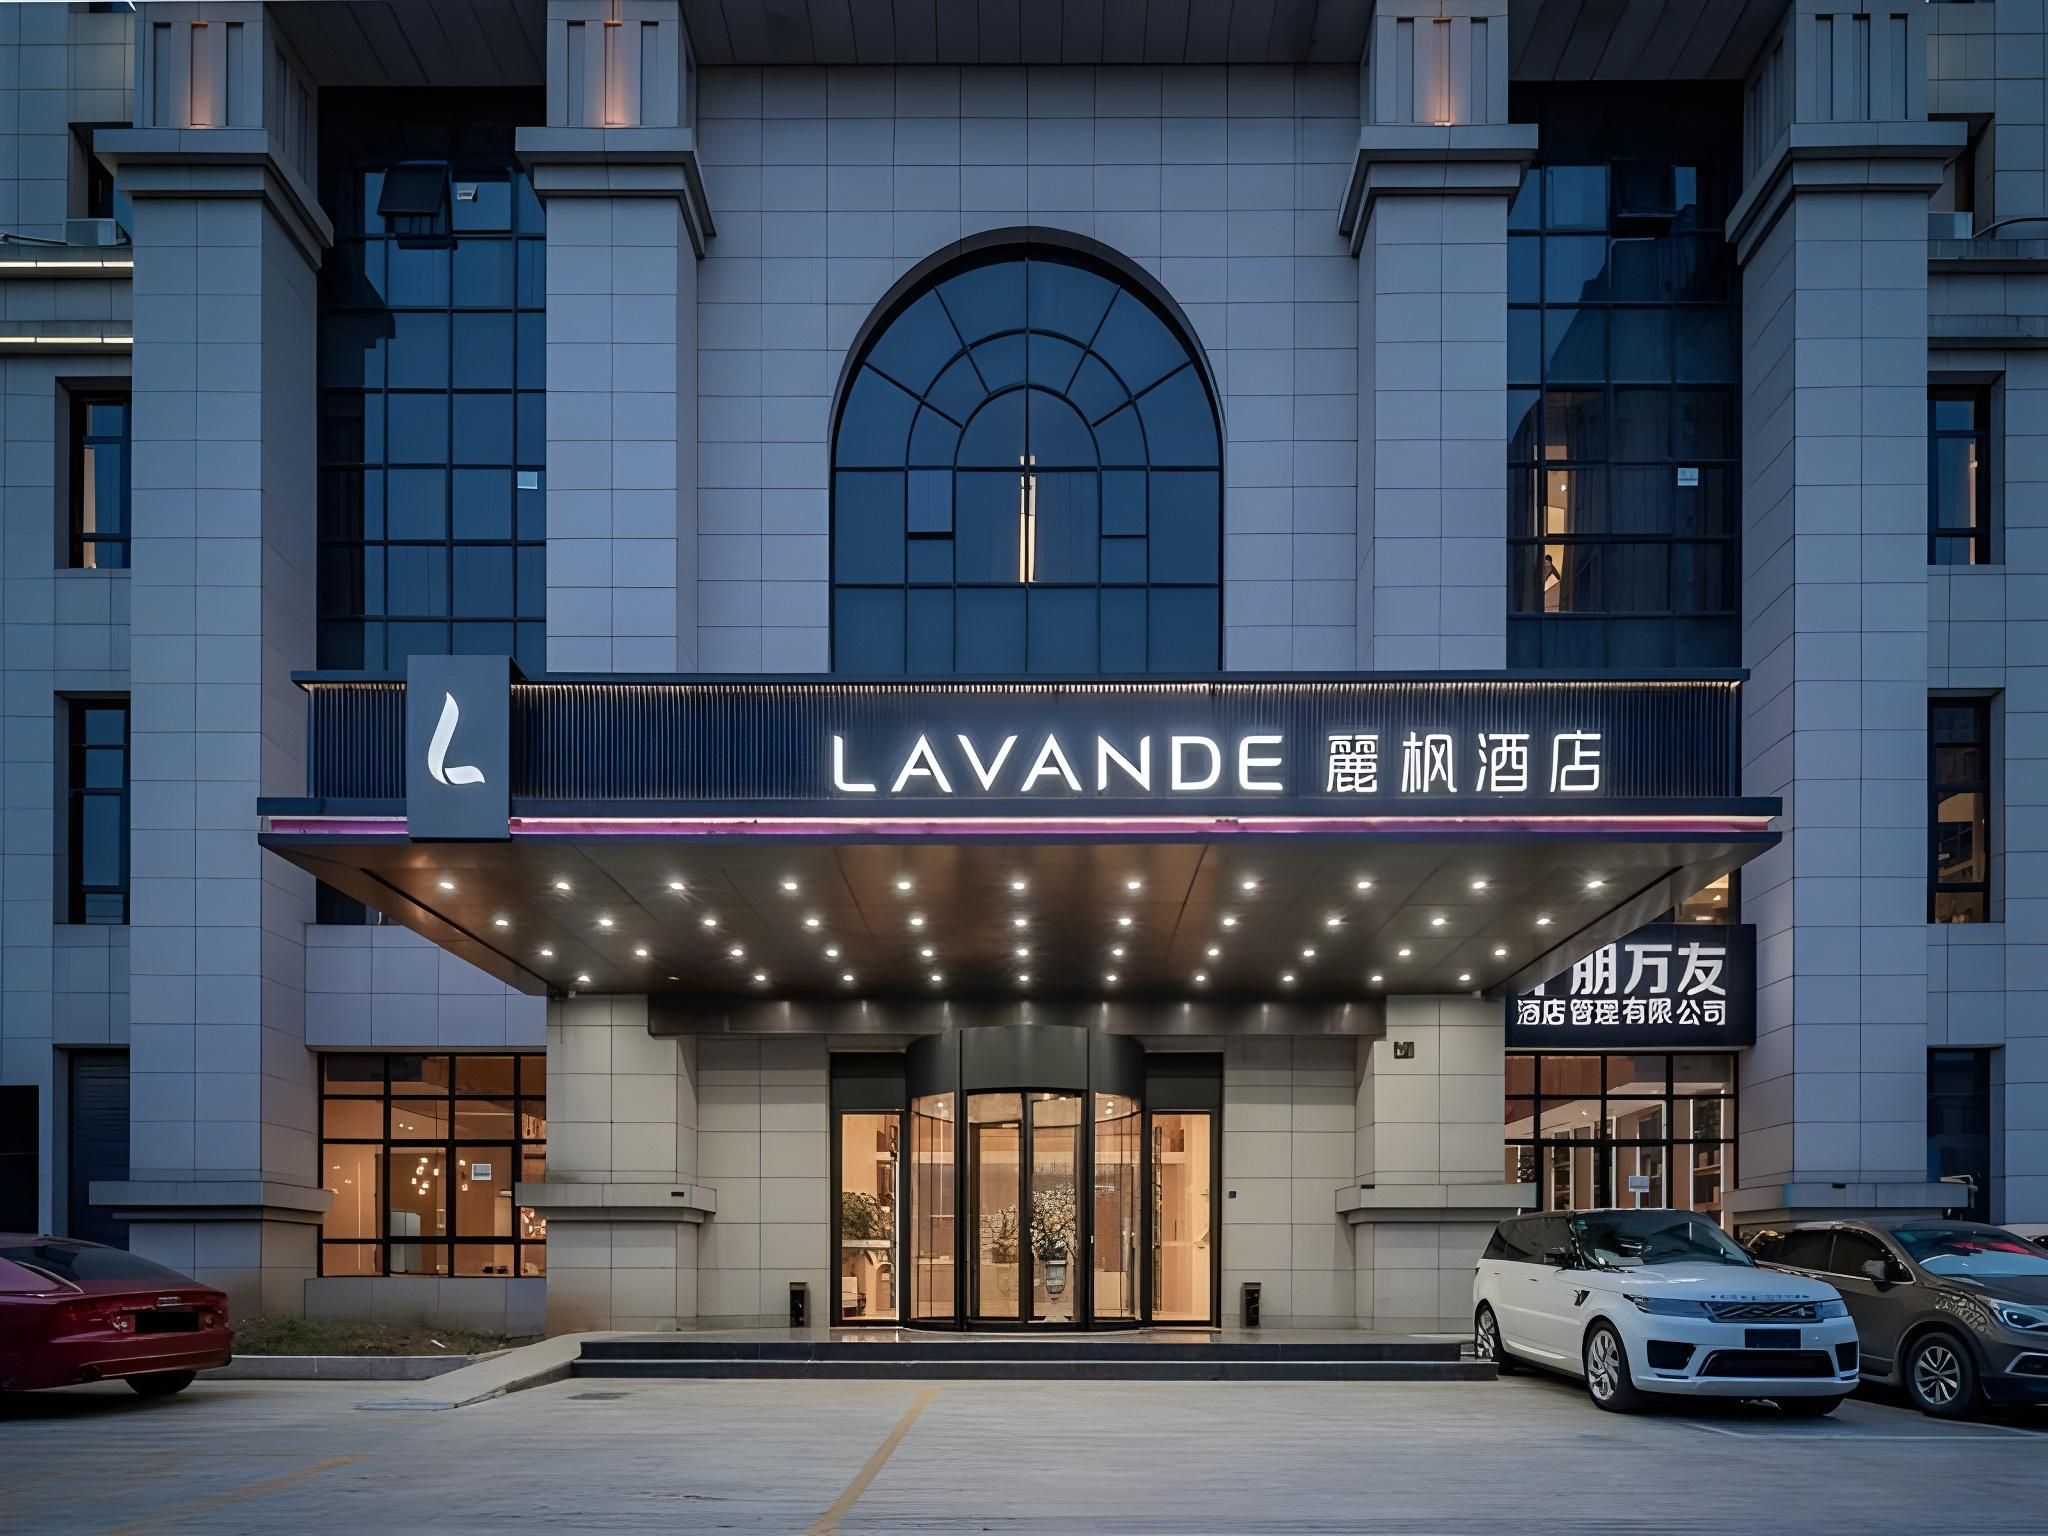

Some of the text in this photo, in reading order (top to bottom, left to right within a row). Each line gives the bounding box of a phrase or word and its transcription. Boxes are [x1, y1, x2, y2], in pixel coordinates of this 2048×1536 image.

[833, 730, 1602, 793] LAVANDE 麗枫酒店
[1534, 942, 1727, 996] 朋万友
